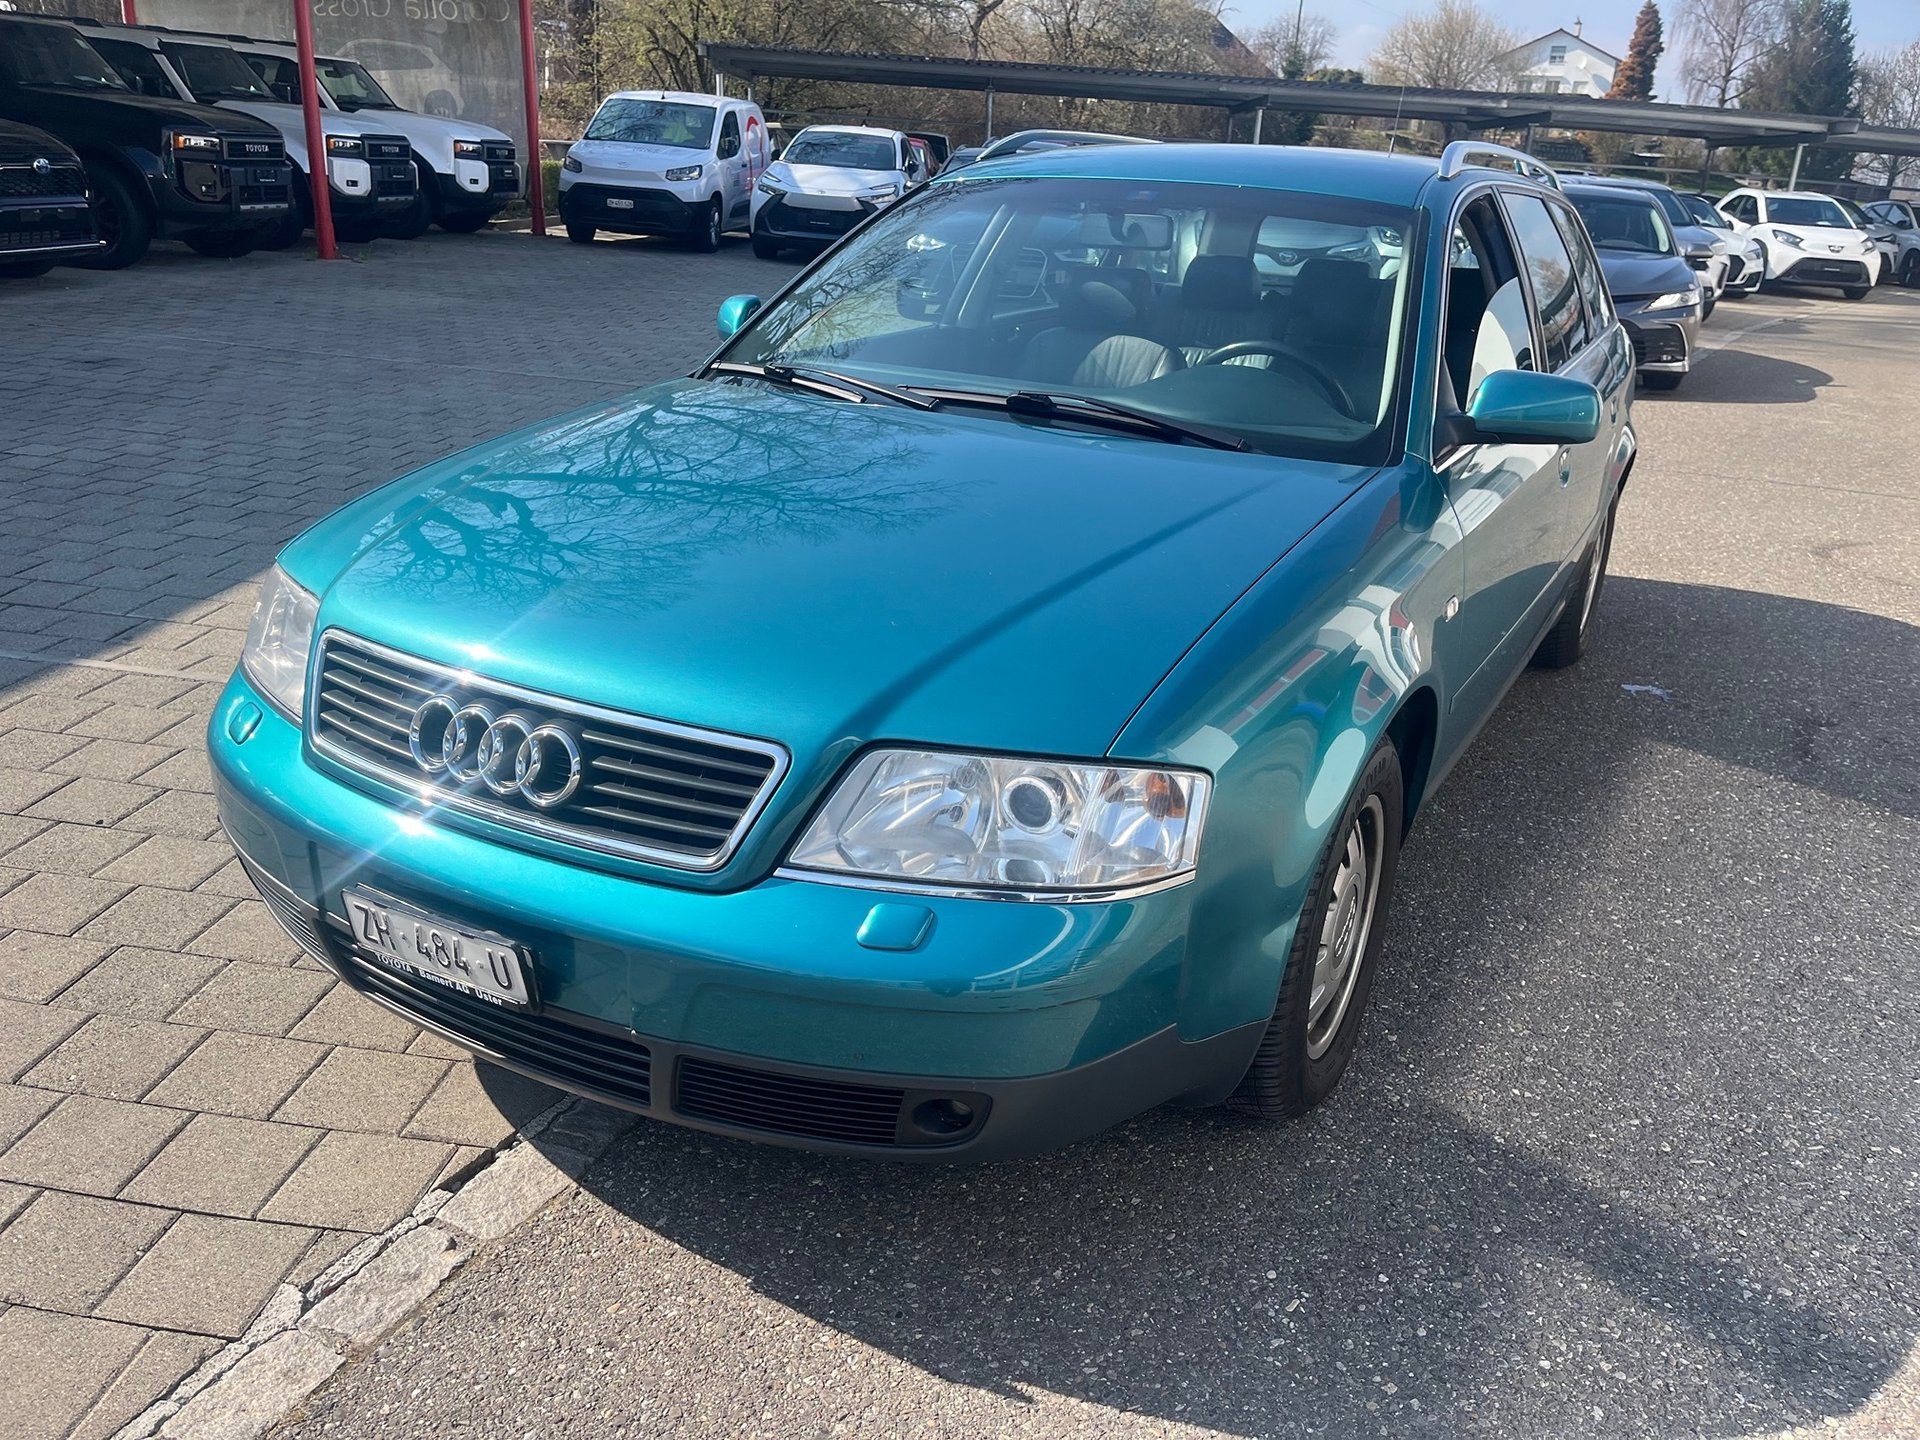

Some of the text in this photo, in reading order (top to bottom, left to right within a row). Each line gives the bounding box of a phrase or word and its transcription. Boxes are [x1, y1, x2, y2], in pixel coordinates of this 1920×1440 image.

[245, 144, 270, 152] TOYOTA
[375, 952, 503, 1006] TOYOTA Bamert AG Uster
